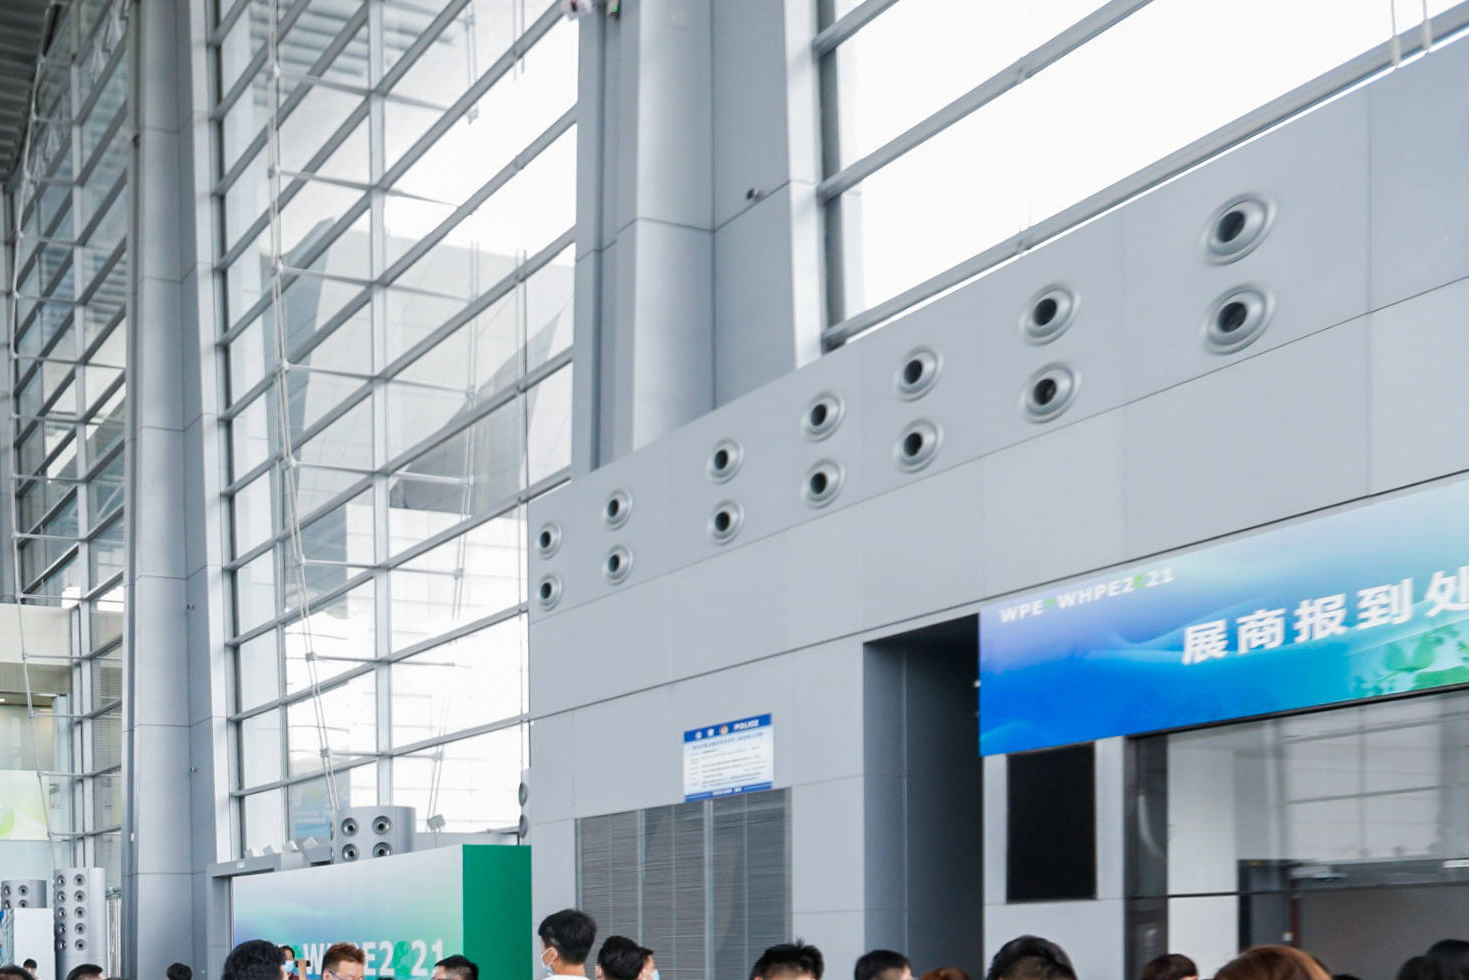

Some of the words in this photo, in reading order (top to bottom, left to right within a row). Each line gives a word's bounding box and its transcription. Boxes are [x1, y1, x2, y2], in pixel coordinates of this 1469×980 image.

[999, 600, 1044, 623] WPE
[1181, 564, 1469, 665] 展商报到处
